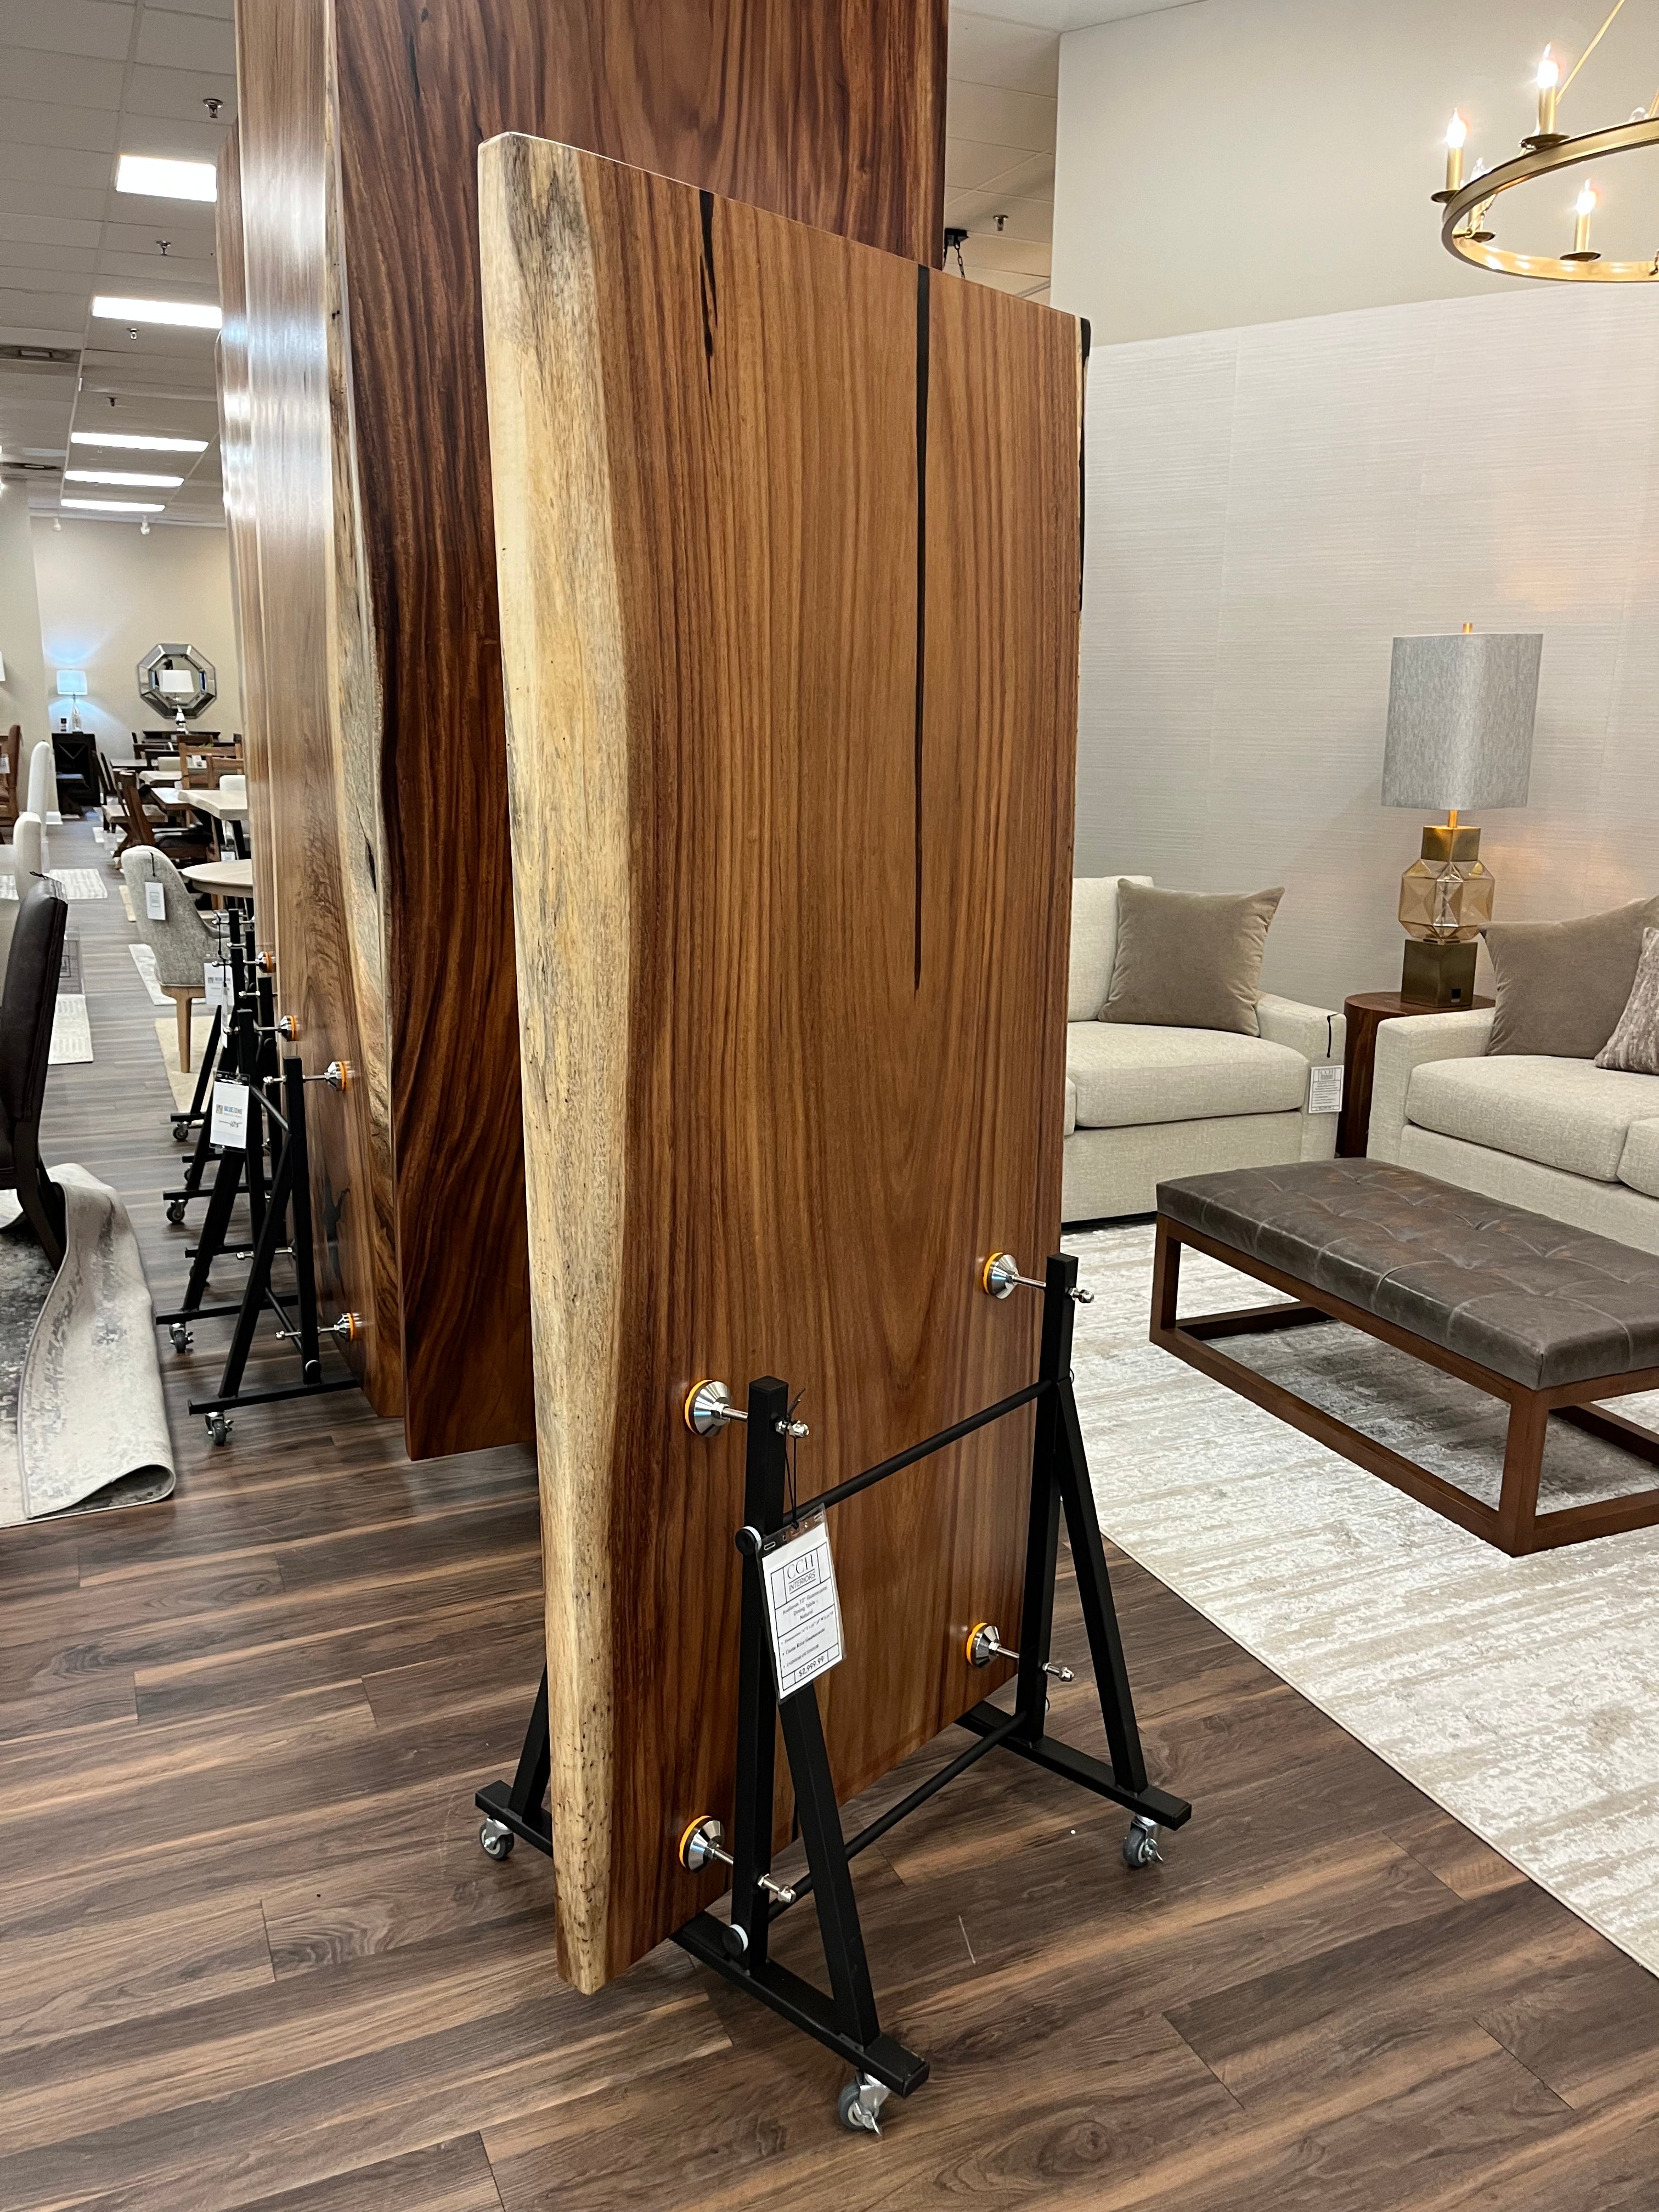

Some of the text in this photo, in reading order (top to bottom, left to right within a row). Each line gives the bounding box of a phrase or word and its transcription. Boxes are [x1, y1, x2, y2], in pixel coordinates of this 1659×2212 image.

[787, 1554, 814, 1579] CCH
[789, 1571, 816, 1592] INTERIORS
[799, 1655, 824, 1677] $2,999.99
